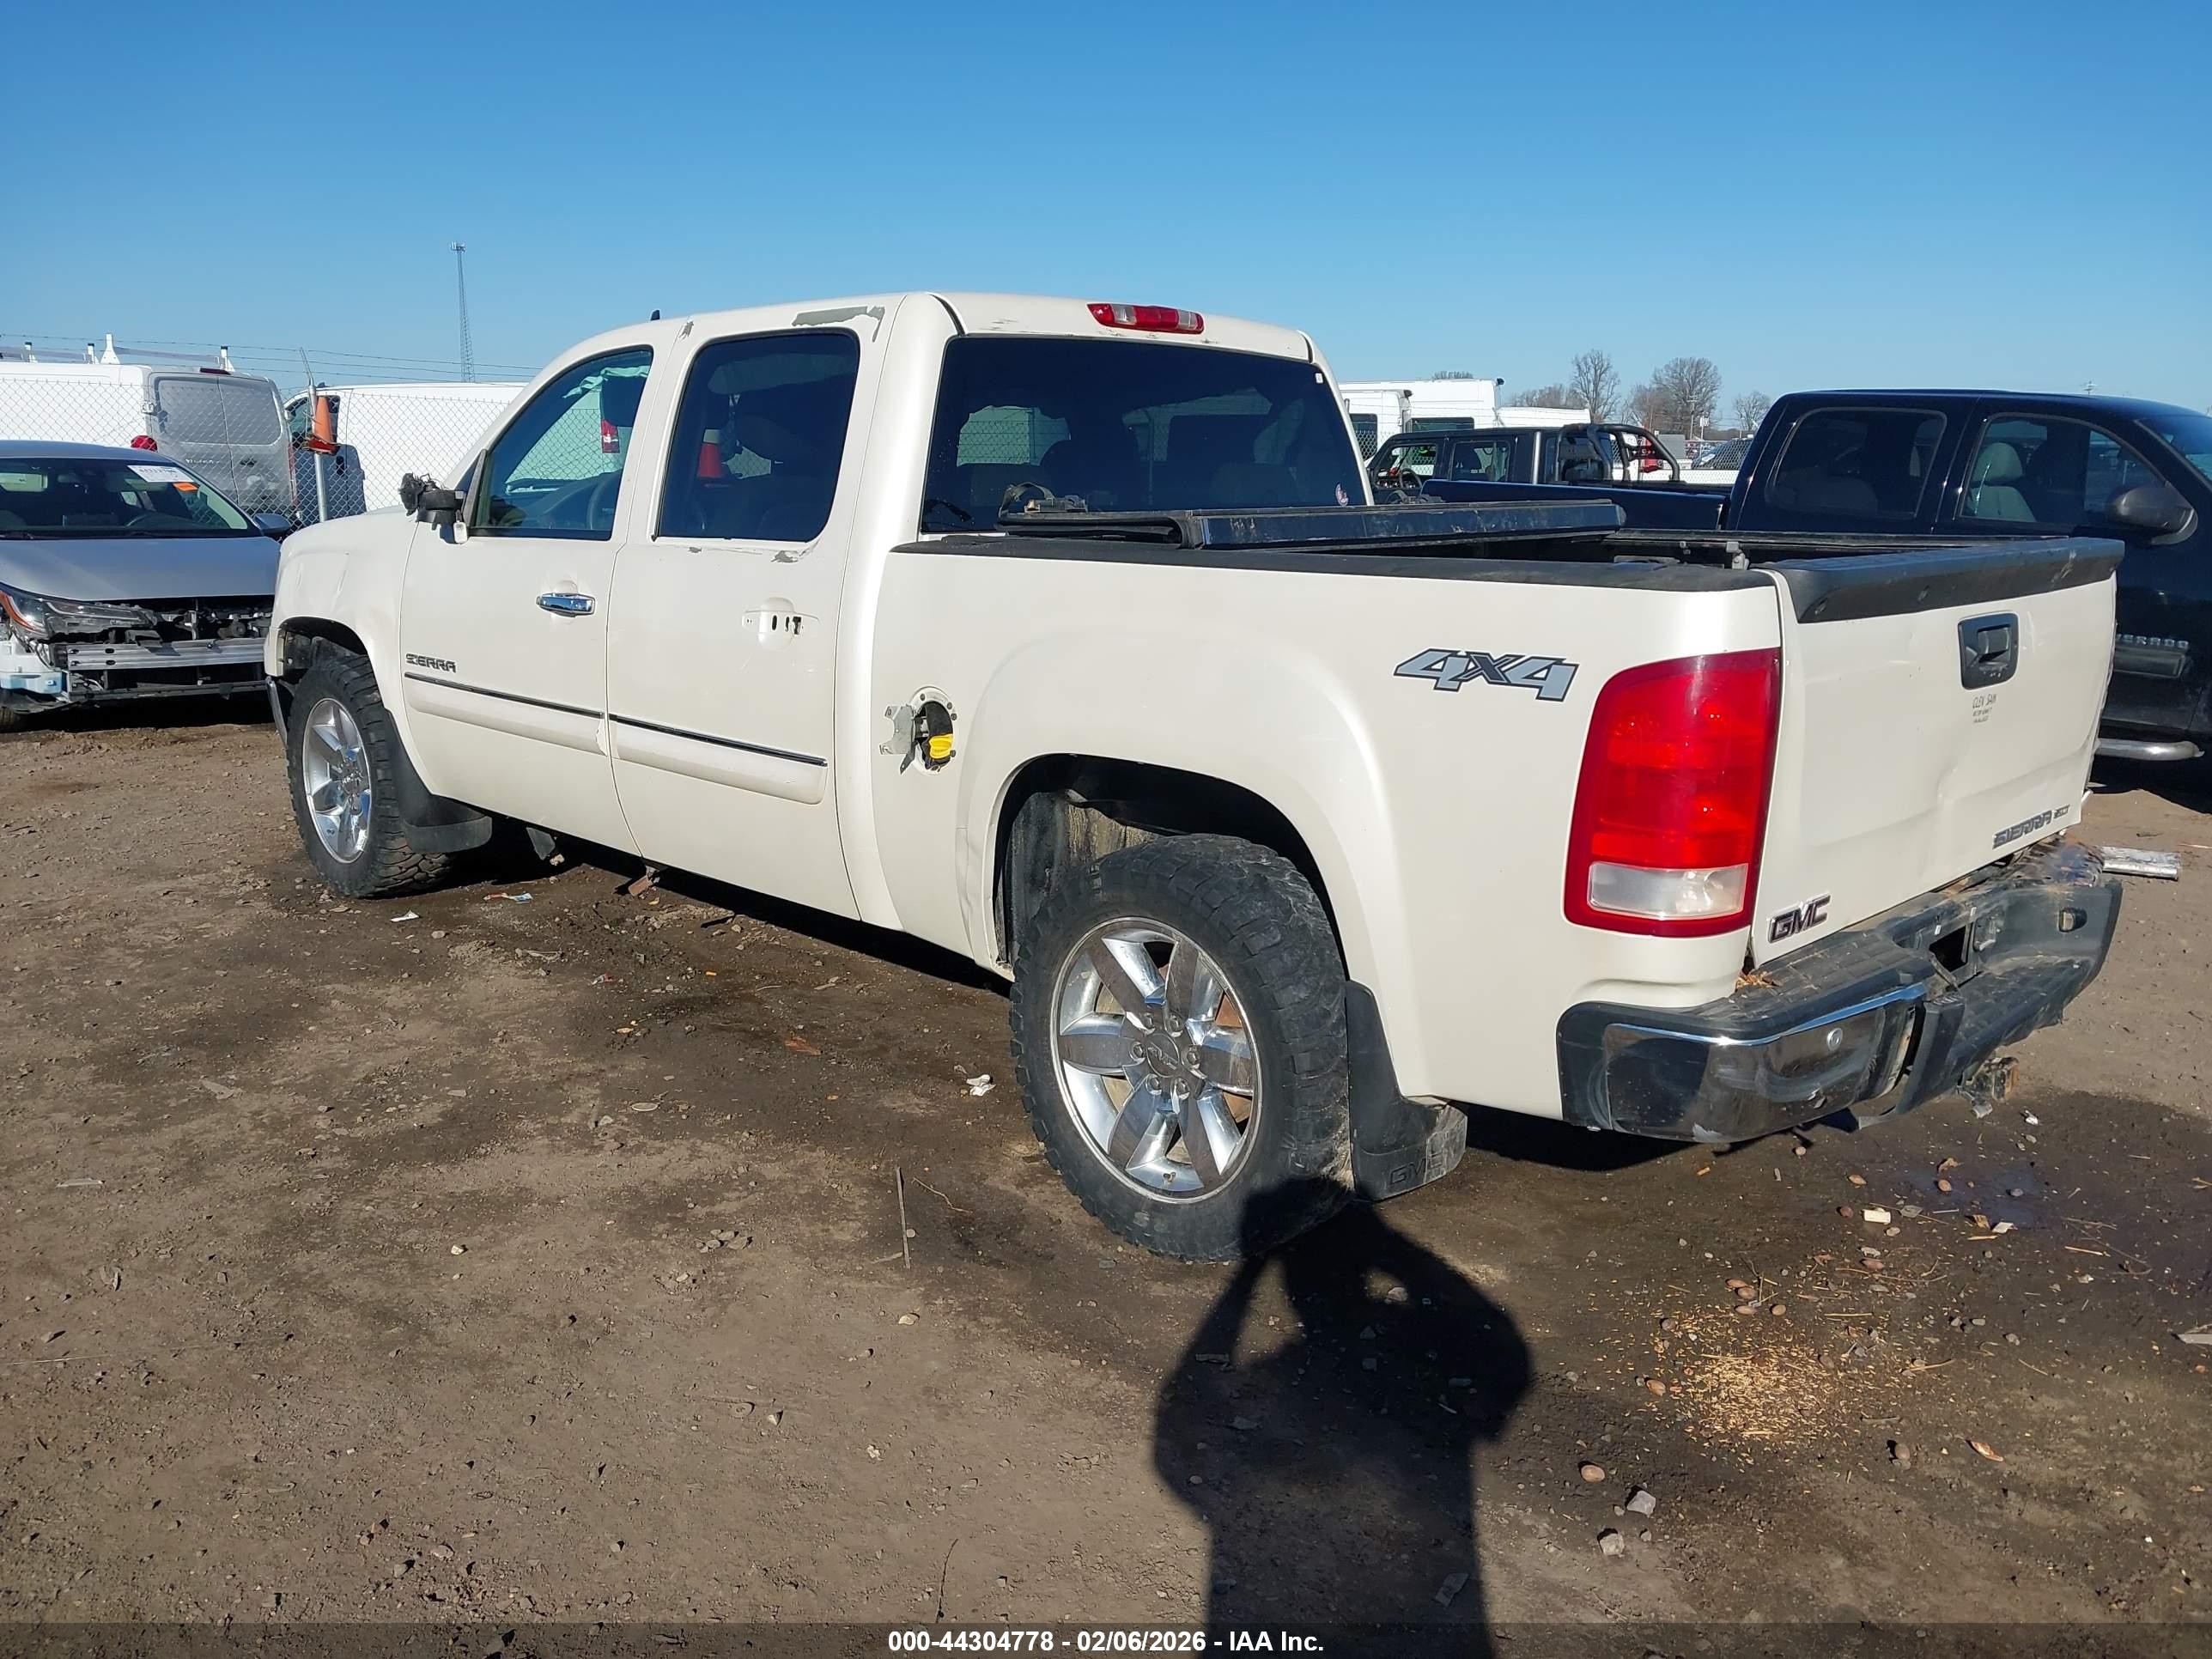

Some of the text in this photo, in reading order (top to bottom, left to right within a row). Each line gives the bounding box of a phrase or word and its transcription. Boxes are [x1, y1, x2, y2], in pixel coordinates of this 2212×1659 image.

[405, 653, 457, 673] SIERRA
[1992, 810, 2052, 849] SIERRA
[1767, 894, 1832, 944] GMC
